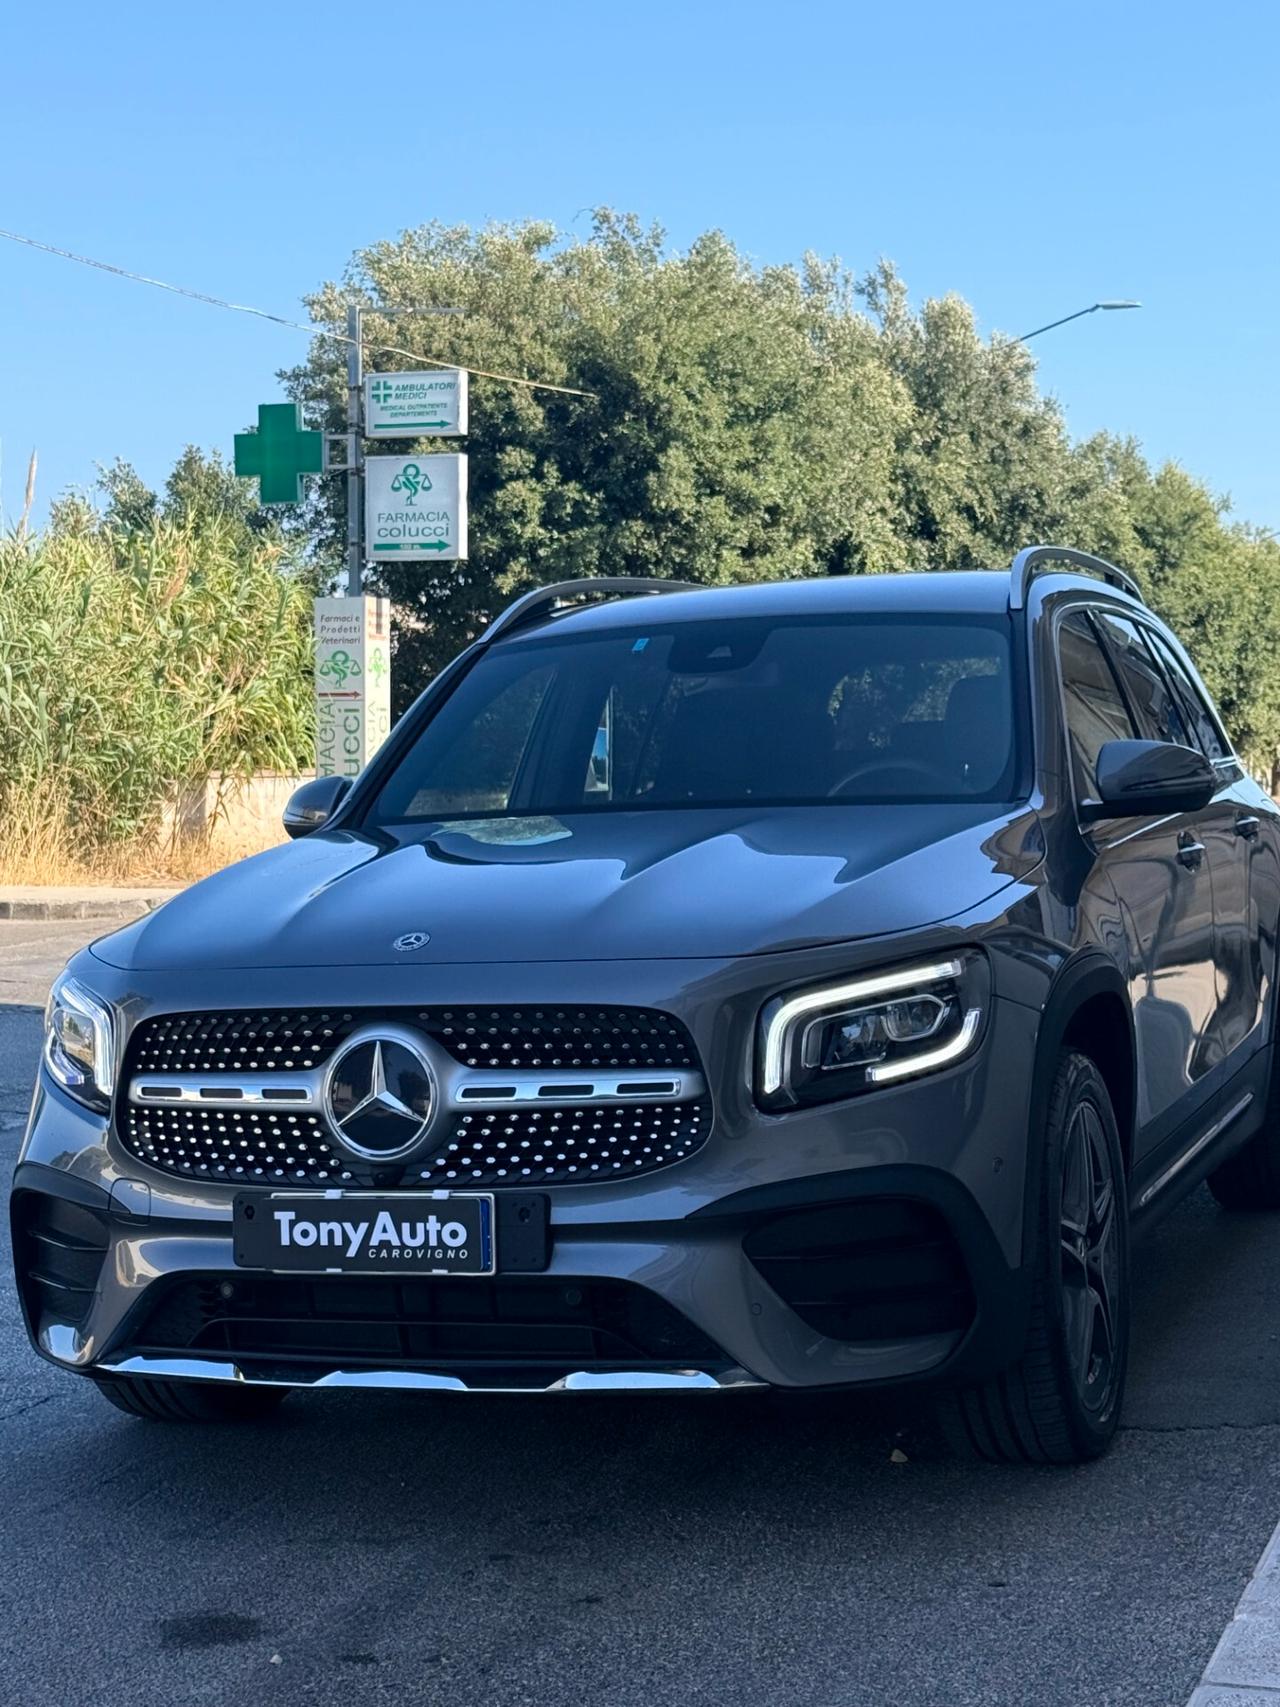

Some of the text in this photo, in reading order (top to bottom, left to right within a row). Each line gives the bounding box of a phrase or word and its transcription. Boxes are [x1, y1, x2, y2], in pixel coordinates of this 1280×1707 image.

[394, 382, 456, 392] AMBULATORI
[394, 392, 427, 400] MEDICI
[377, 512, 450, 523] FARMACIA
[377, 523, 449, 538] colucci
[320, 614, 354, 623] Farmaci
[320, 625, 361, 633] Prodotti
[320, 636, 361, 645] Veterinari
[320, 702, 336, 777] MACIA
[337, 708, 360, 777] ucci
[273, 1211, 468, 1258] TonyAuto
[368, 1249, 469, 1259] CAROVIGNO
